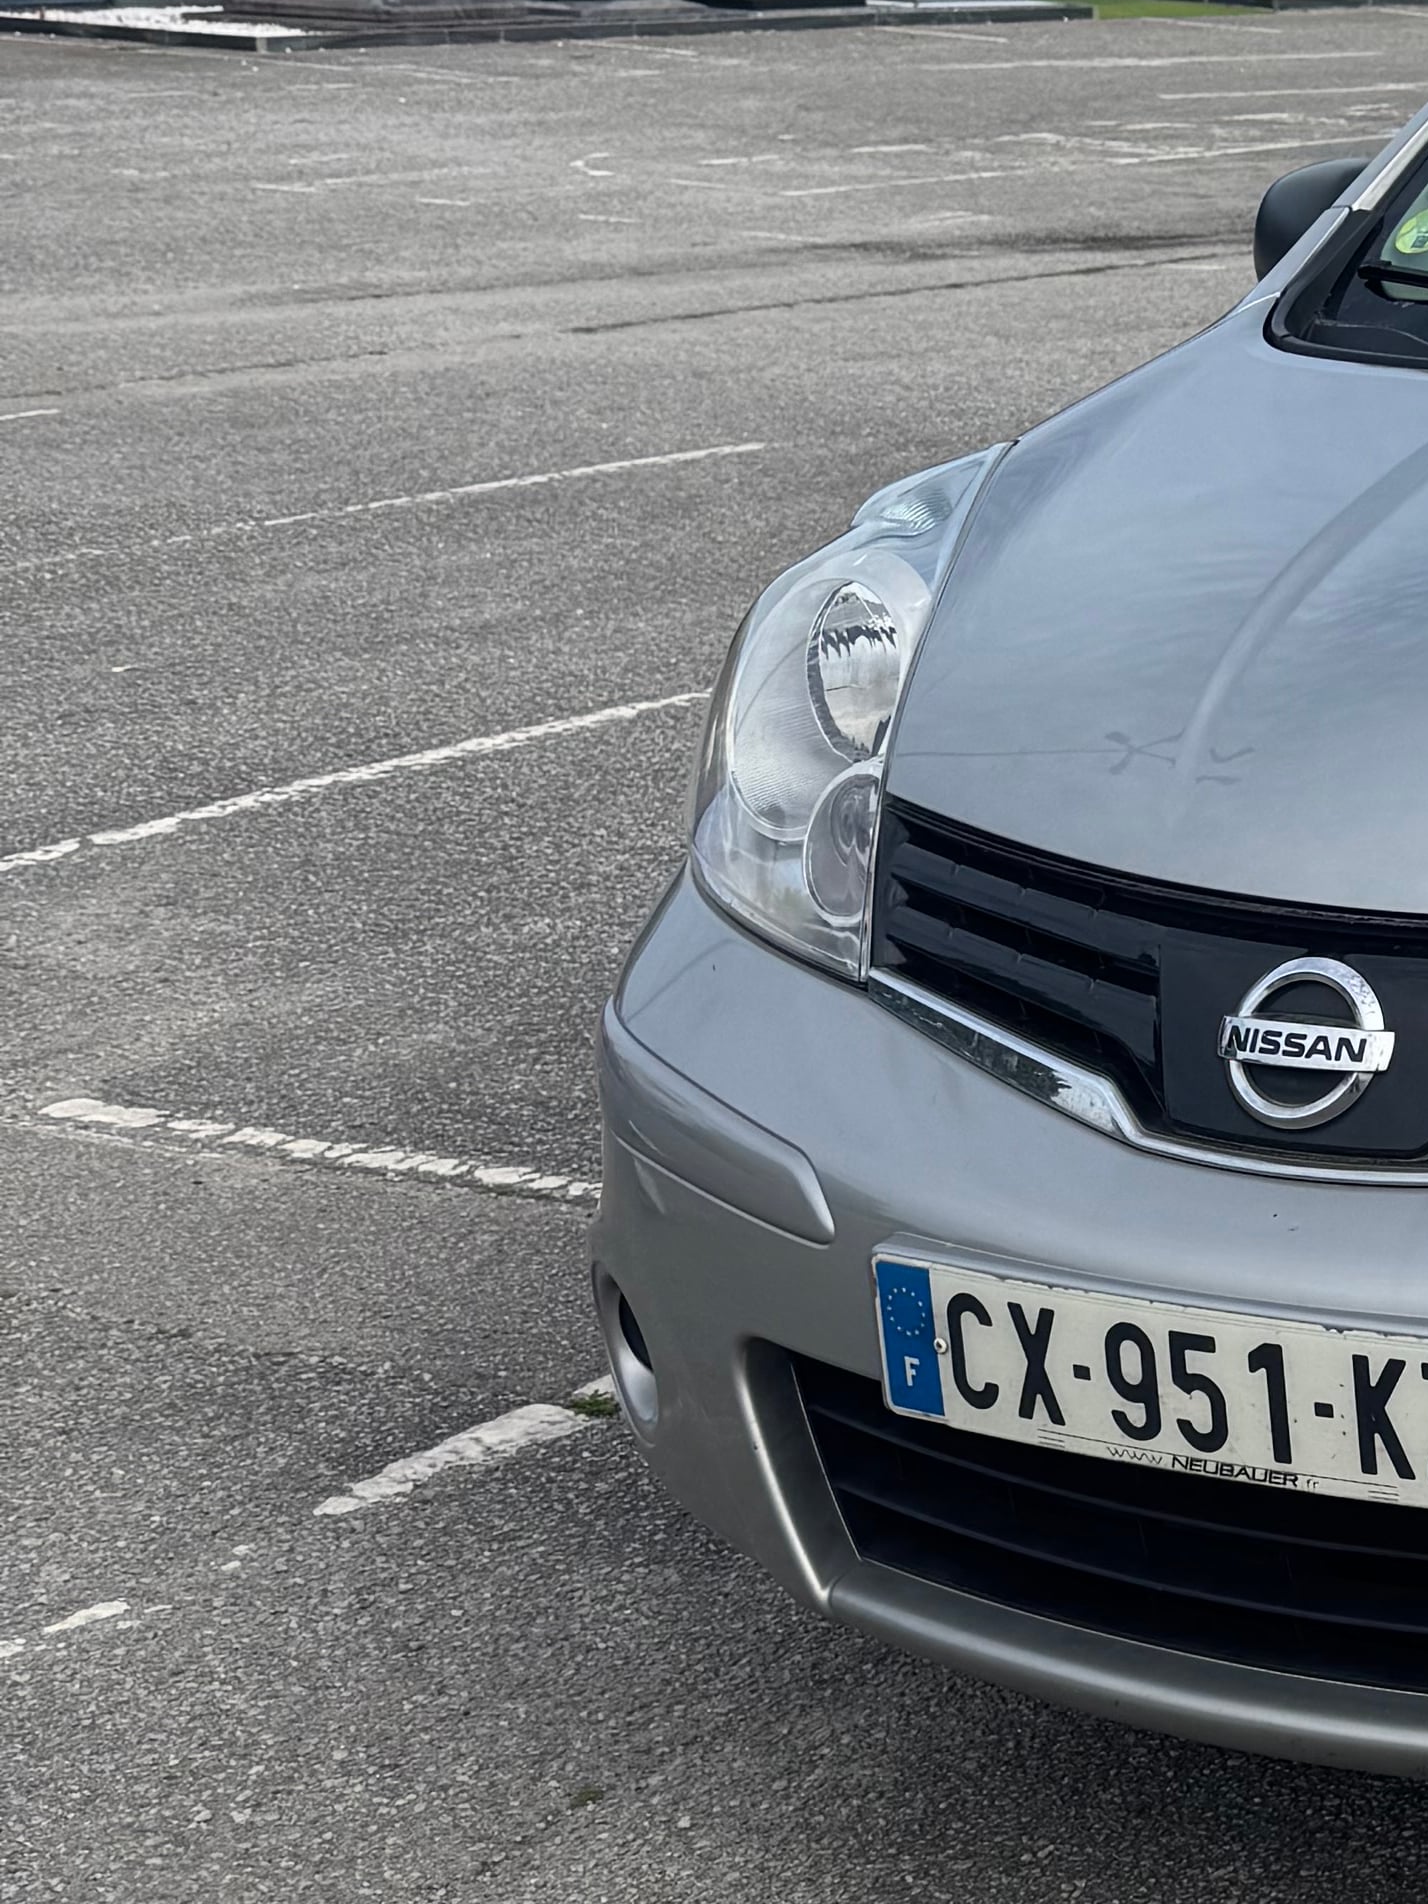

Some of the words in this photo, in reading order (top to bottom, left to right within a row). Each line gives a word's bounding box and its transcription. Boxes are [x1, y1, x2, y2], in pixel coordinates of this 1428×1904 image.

[1226, 1025, 1367, 1062] NISSAN
[903, 1356, 920, 1387] F
[1171, 1454, 1299, 1487] NEUBAUER
